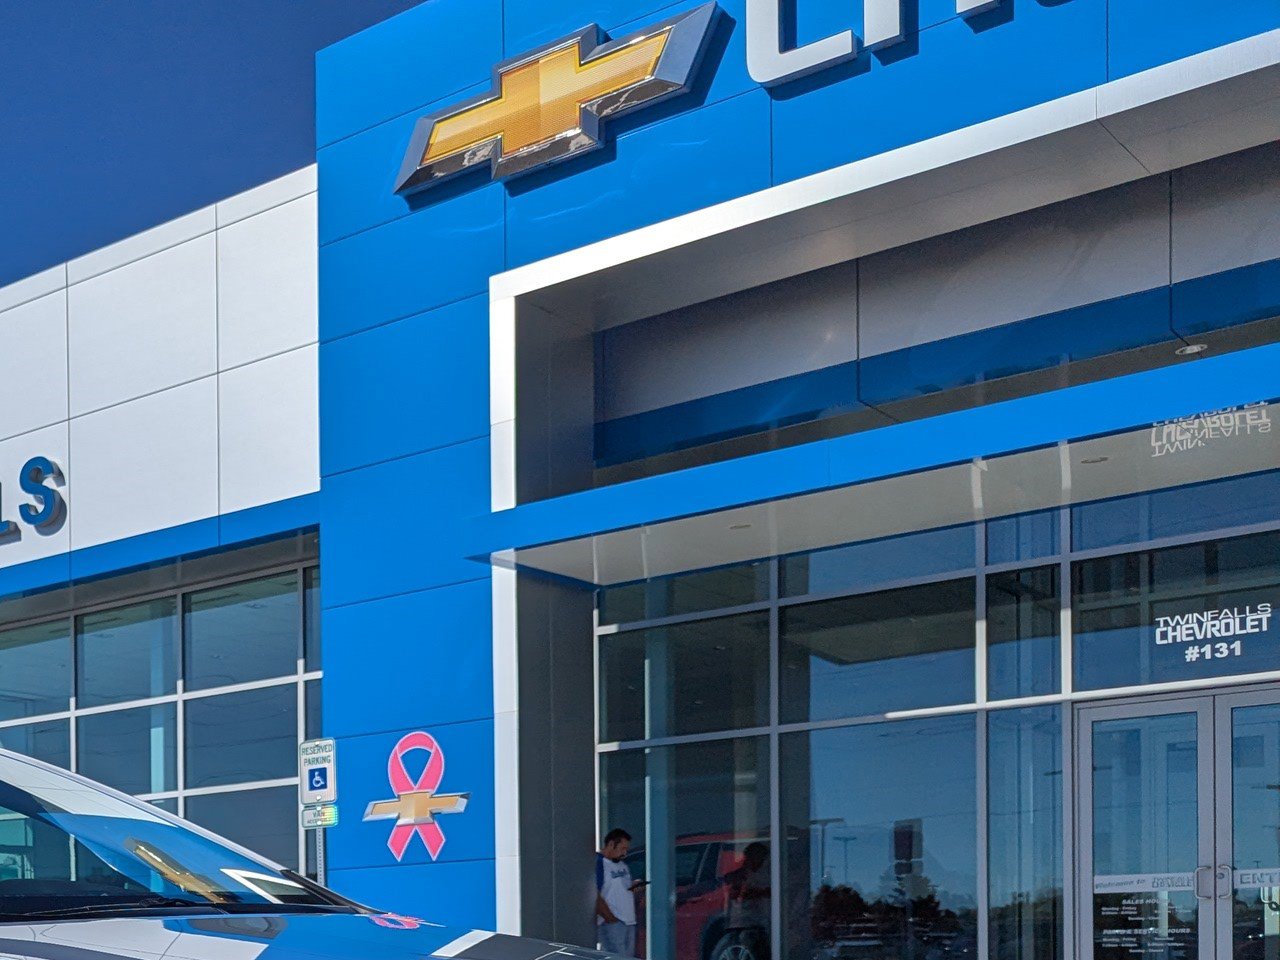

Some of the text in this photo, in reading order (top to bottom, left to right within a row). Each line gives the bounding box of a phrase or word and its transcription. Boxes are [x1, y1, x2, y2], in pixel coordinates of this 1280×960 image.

[1155, 613, 1272, 645] CHEVROLET
[1185, 640, 1242, 662] #131
[301, 743, 332, 756] RESERVED
[303, 755, 331, 767] PARKING
